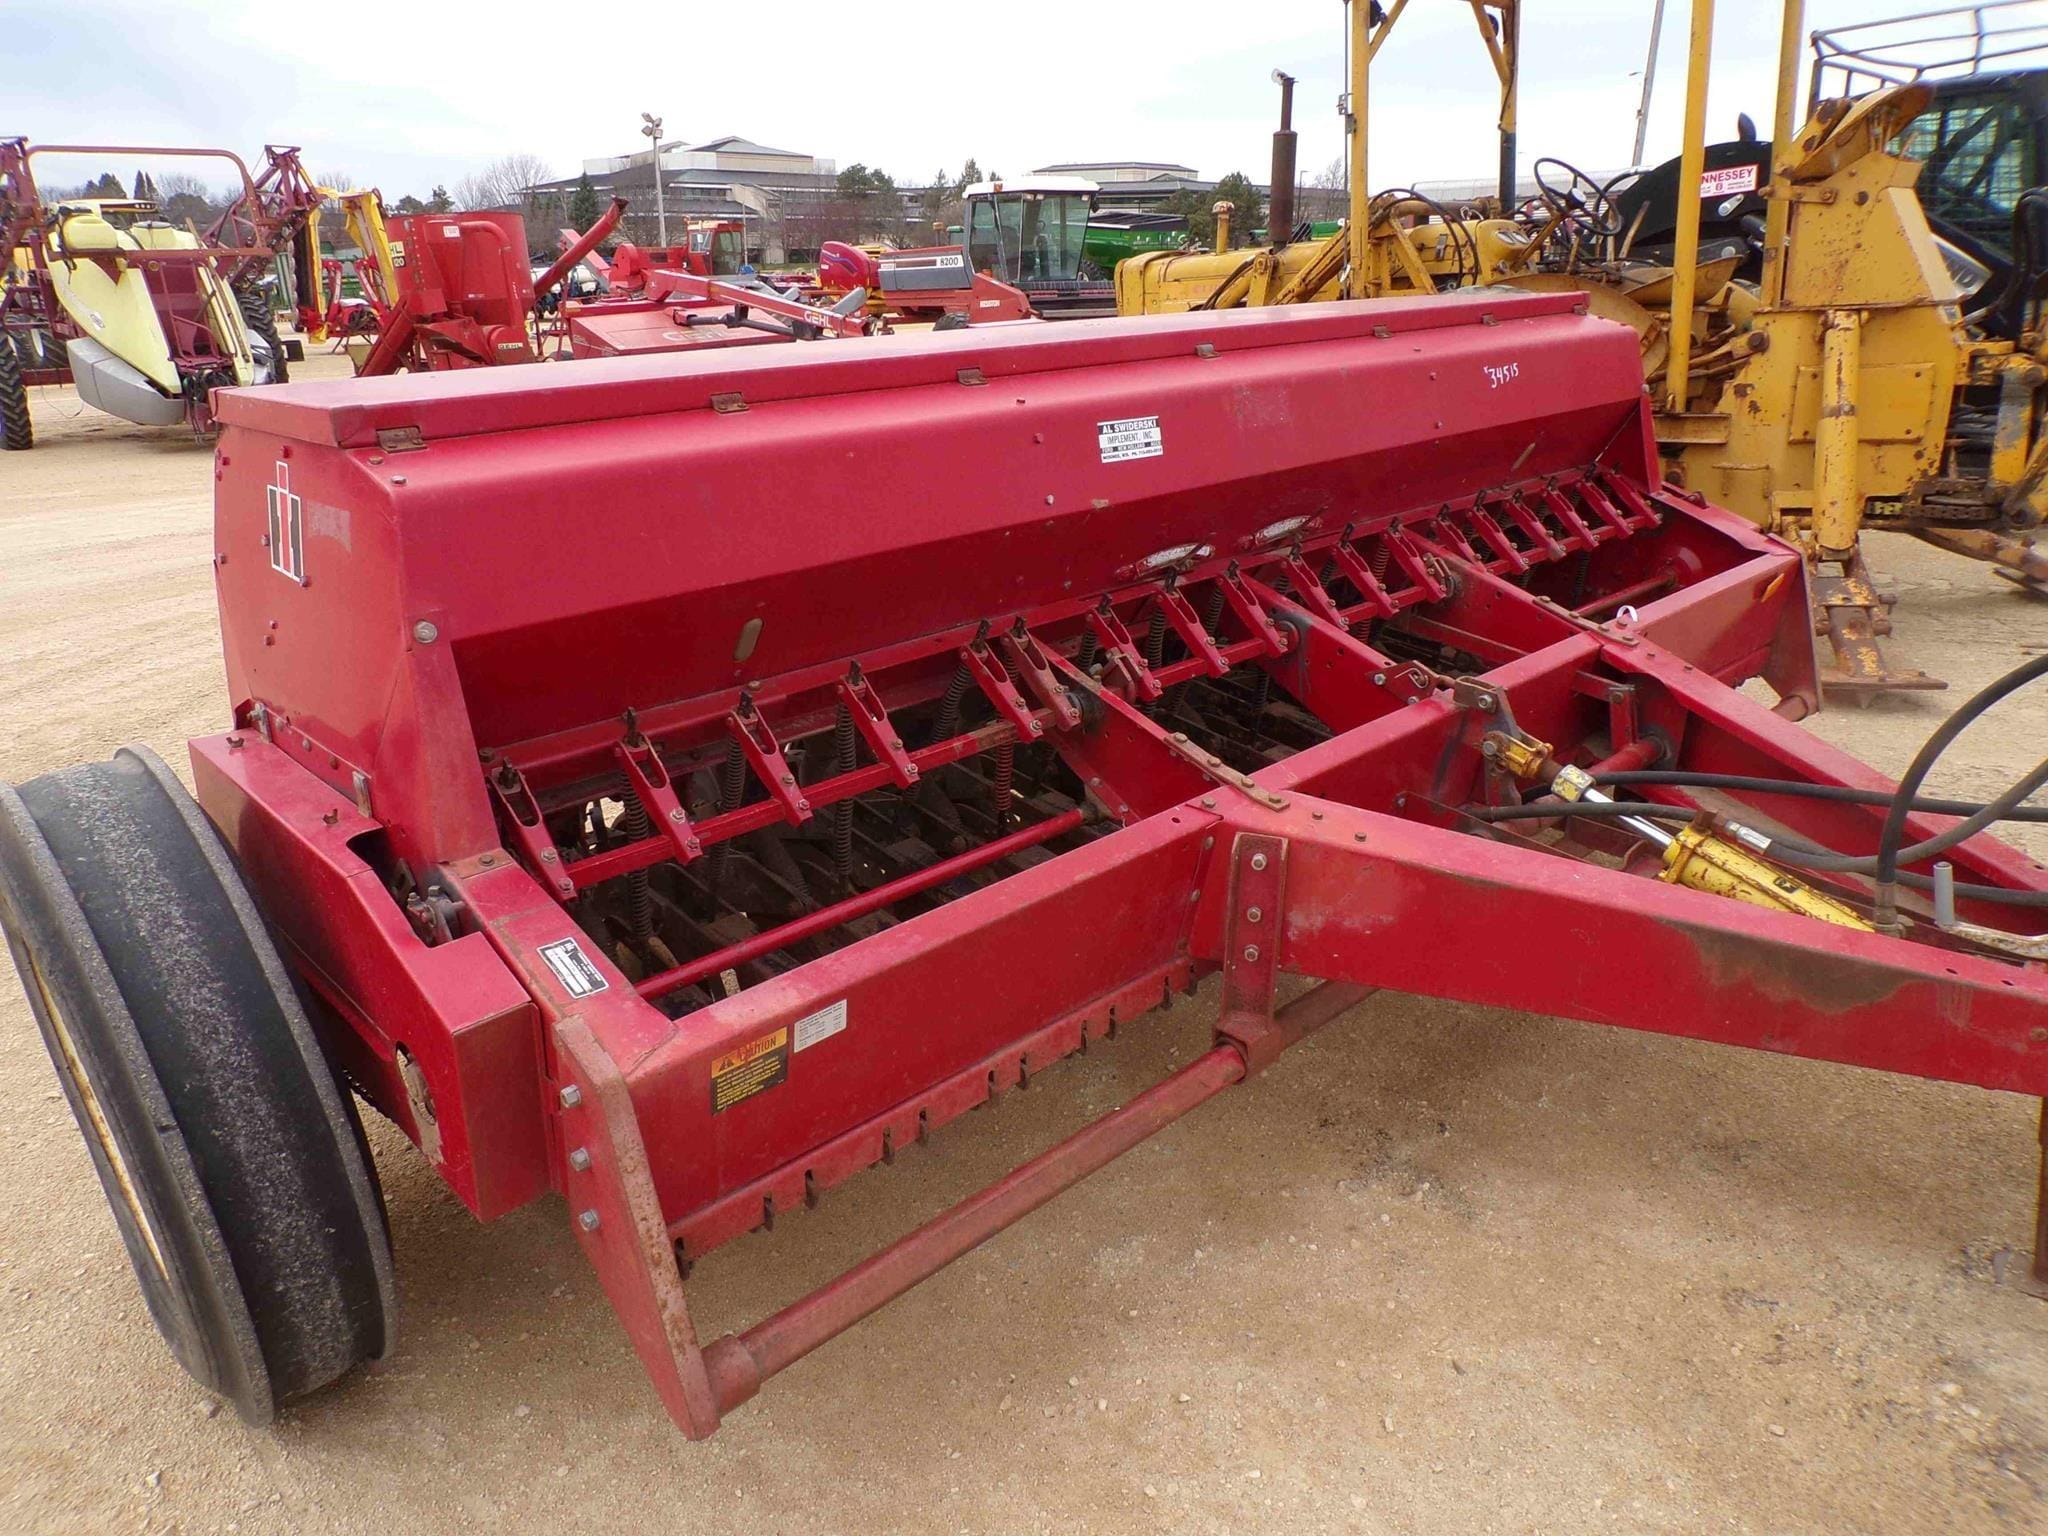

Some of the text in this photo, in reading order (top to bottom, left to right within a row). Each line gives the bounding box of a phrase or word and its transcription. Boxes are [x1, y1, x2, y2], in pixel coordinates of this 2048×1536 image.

[1701, 167, 1754, 184] NNESSEY
[939, 256, 960, 267] 8200
[803, 312, 833, 328] GEHL
[1102, 419, 1157, 435] AL SWIDERSKI
[1106, 431, 1141, 446] IMPLEMENT,
